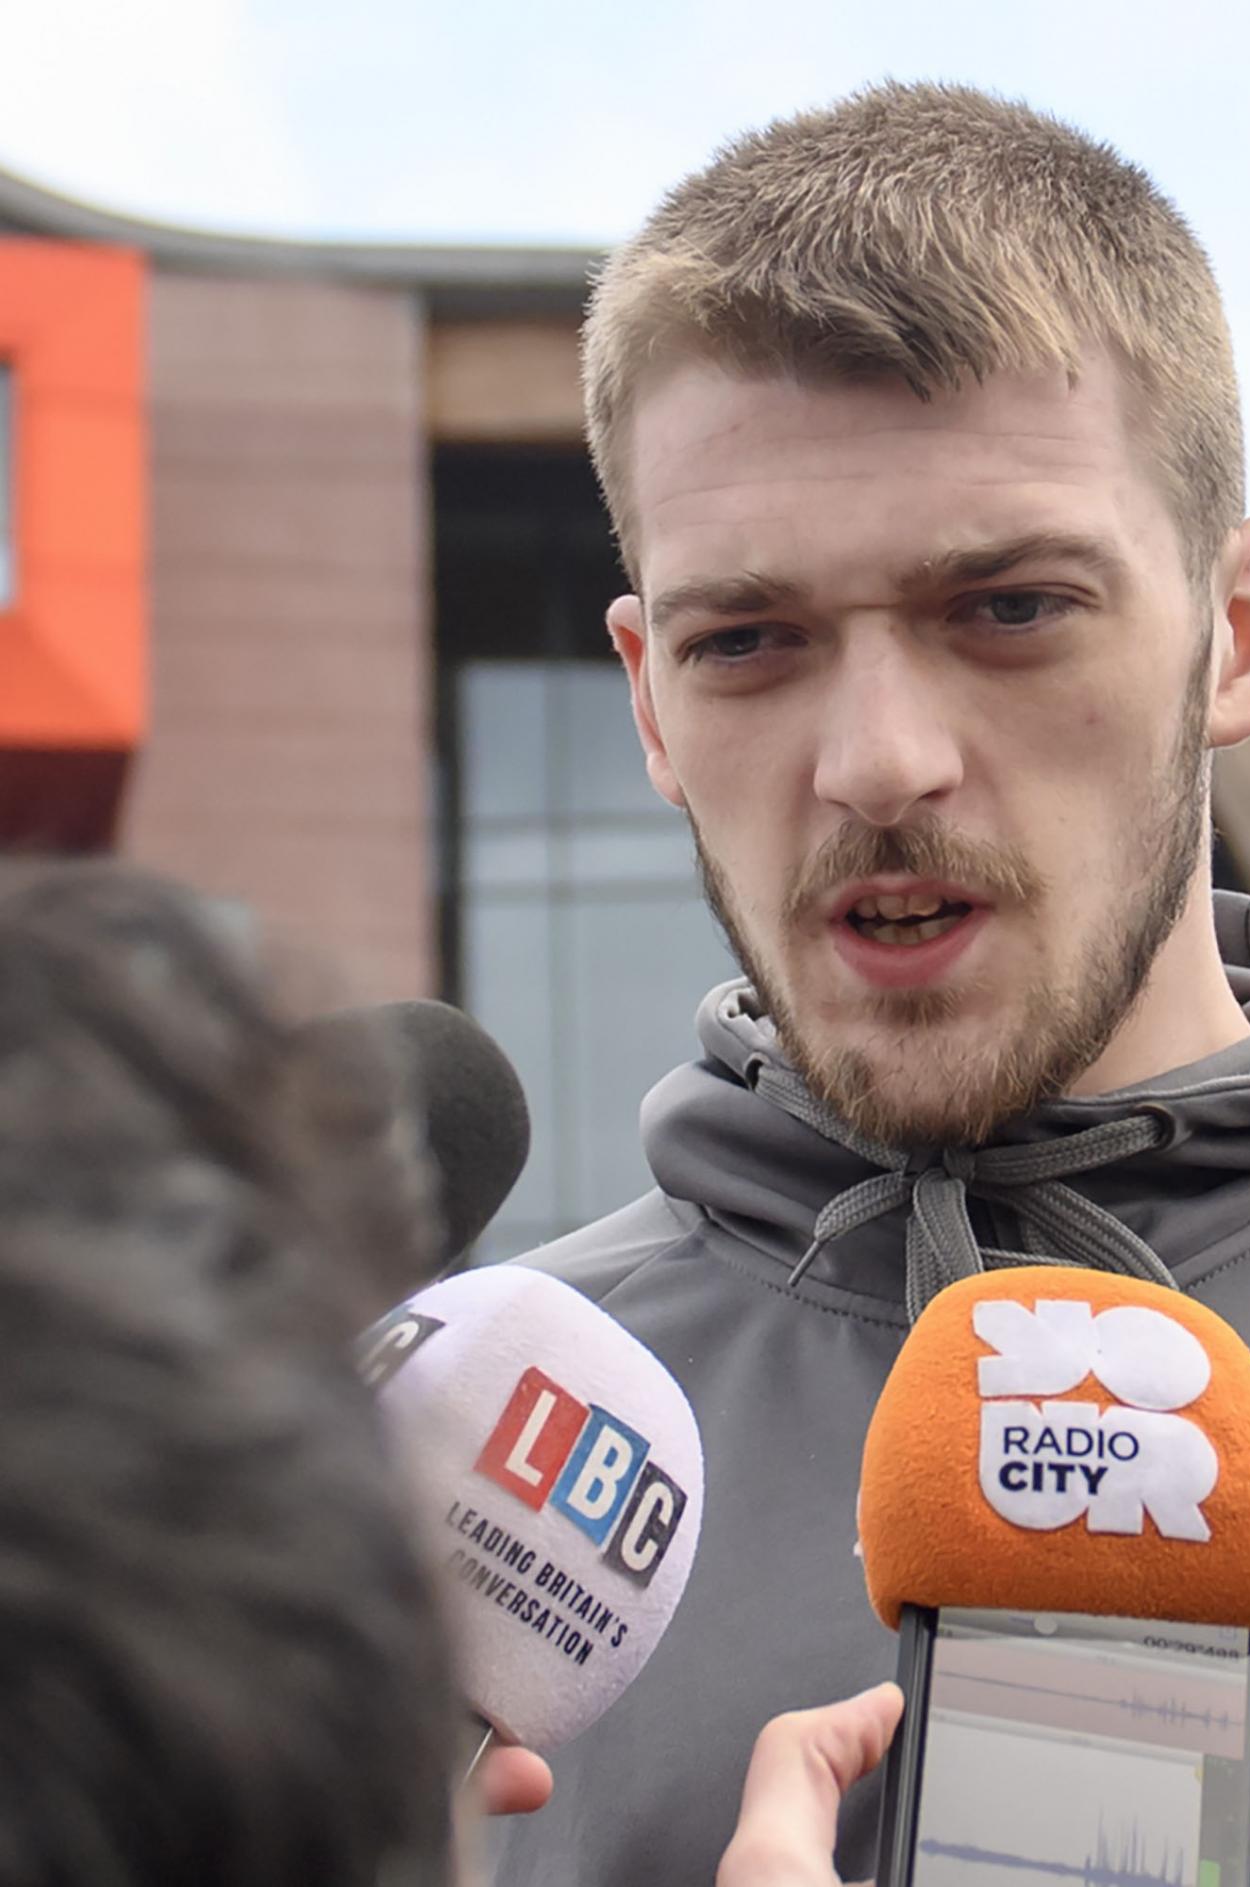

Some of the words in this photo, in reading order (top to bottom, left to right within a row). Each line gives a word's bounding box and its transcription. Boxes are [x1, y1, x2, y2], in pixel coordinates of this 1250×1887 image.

[504, 1389, 674, 1572] LBC
[999, 1461, 1108, 1495] CITY
[1003, 1426, 1140, 1461] RADIO
[445, 1501, 536, 1575] LEADING
[535, 1562, 629, 1648] BRITAIN'S
[449, 1549, 594, 1665] CONVERSATION
